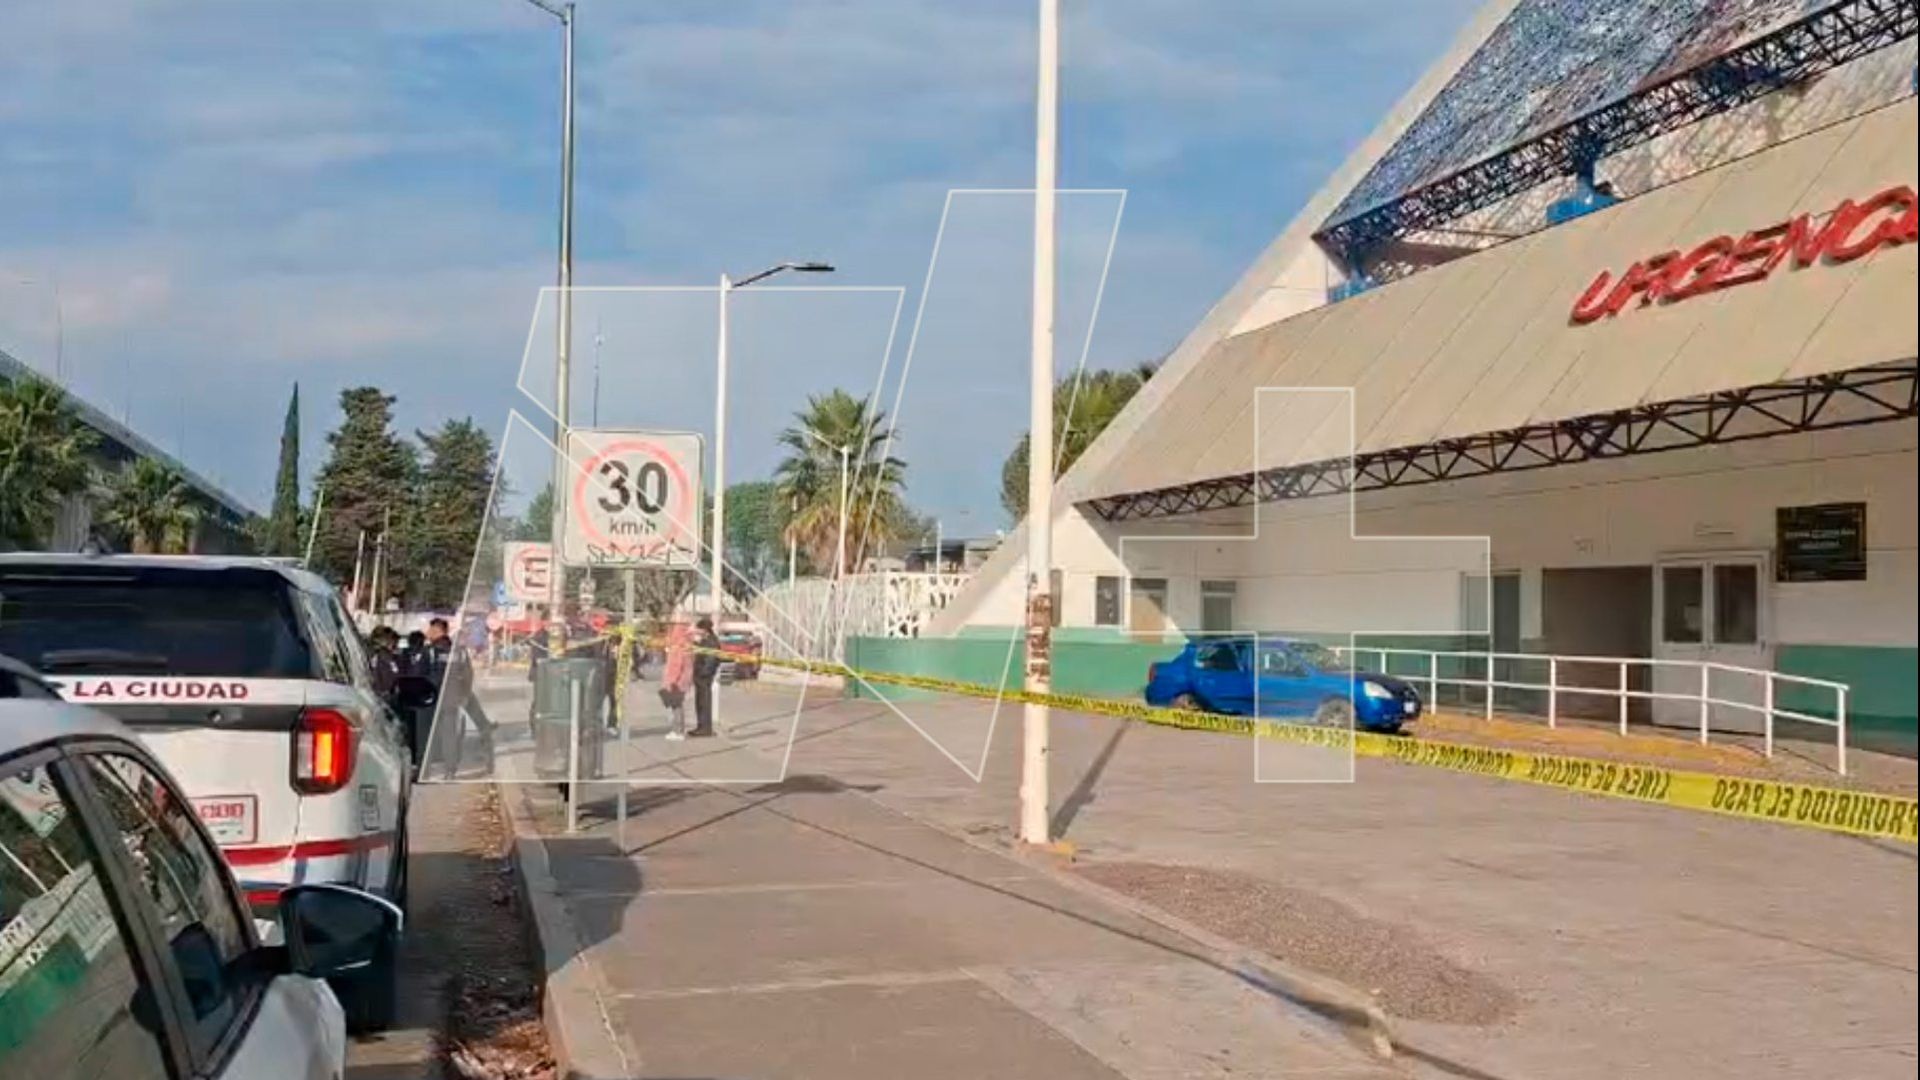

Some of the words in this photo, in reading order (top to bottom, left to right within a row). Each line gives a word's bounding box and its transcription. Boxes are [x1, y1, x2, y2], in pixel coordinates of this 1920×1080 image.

[598, 460, 669, 514] 30
[609, 518, 656, 535] km/h
[74, 681, 115, 697] LA
[126, 682, 249, 699] CIUDAD
